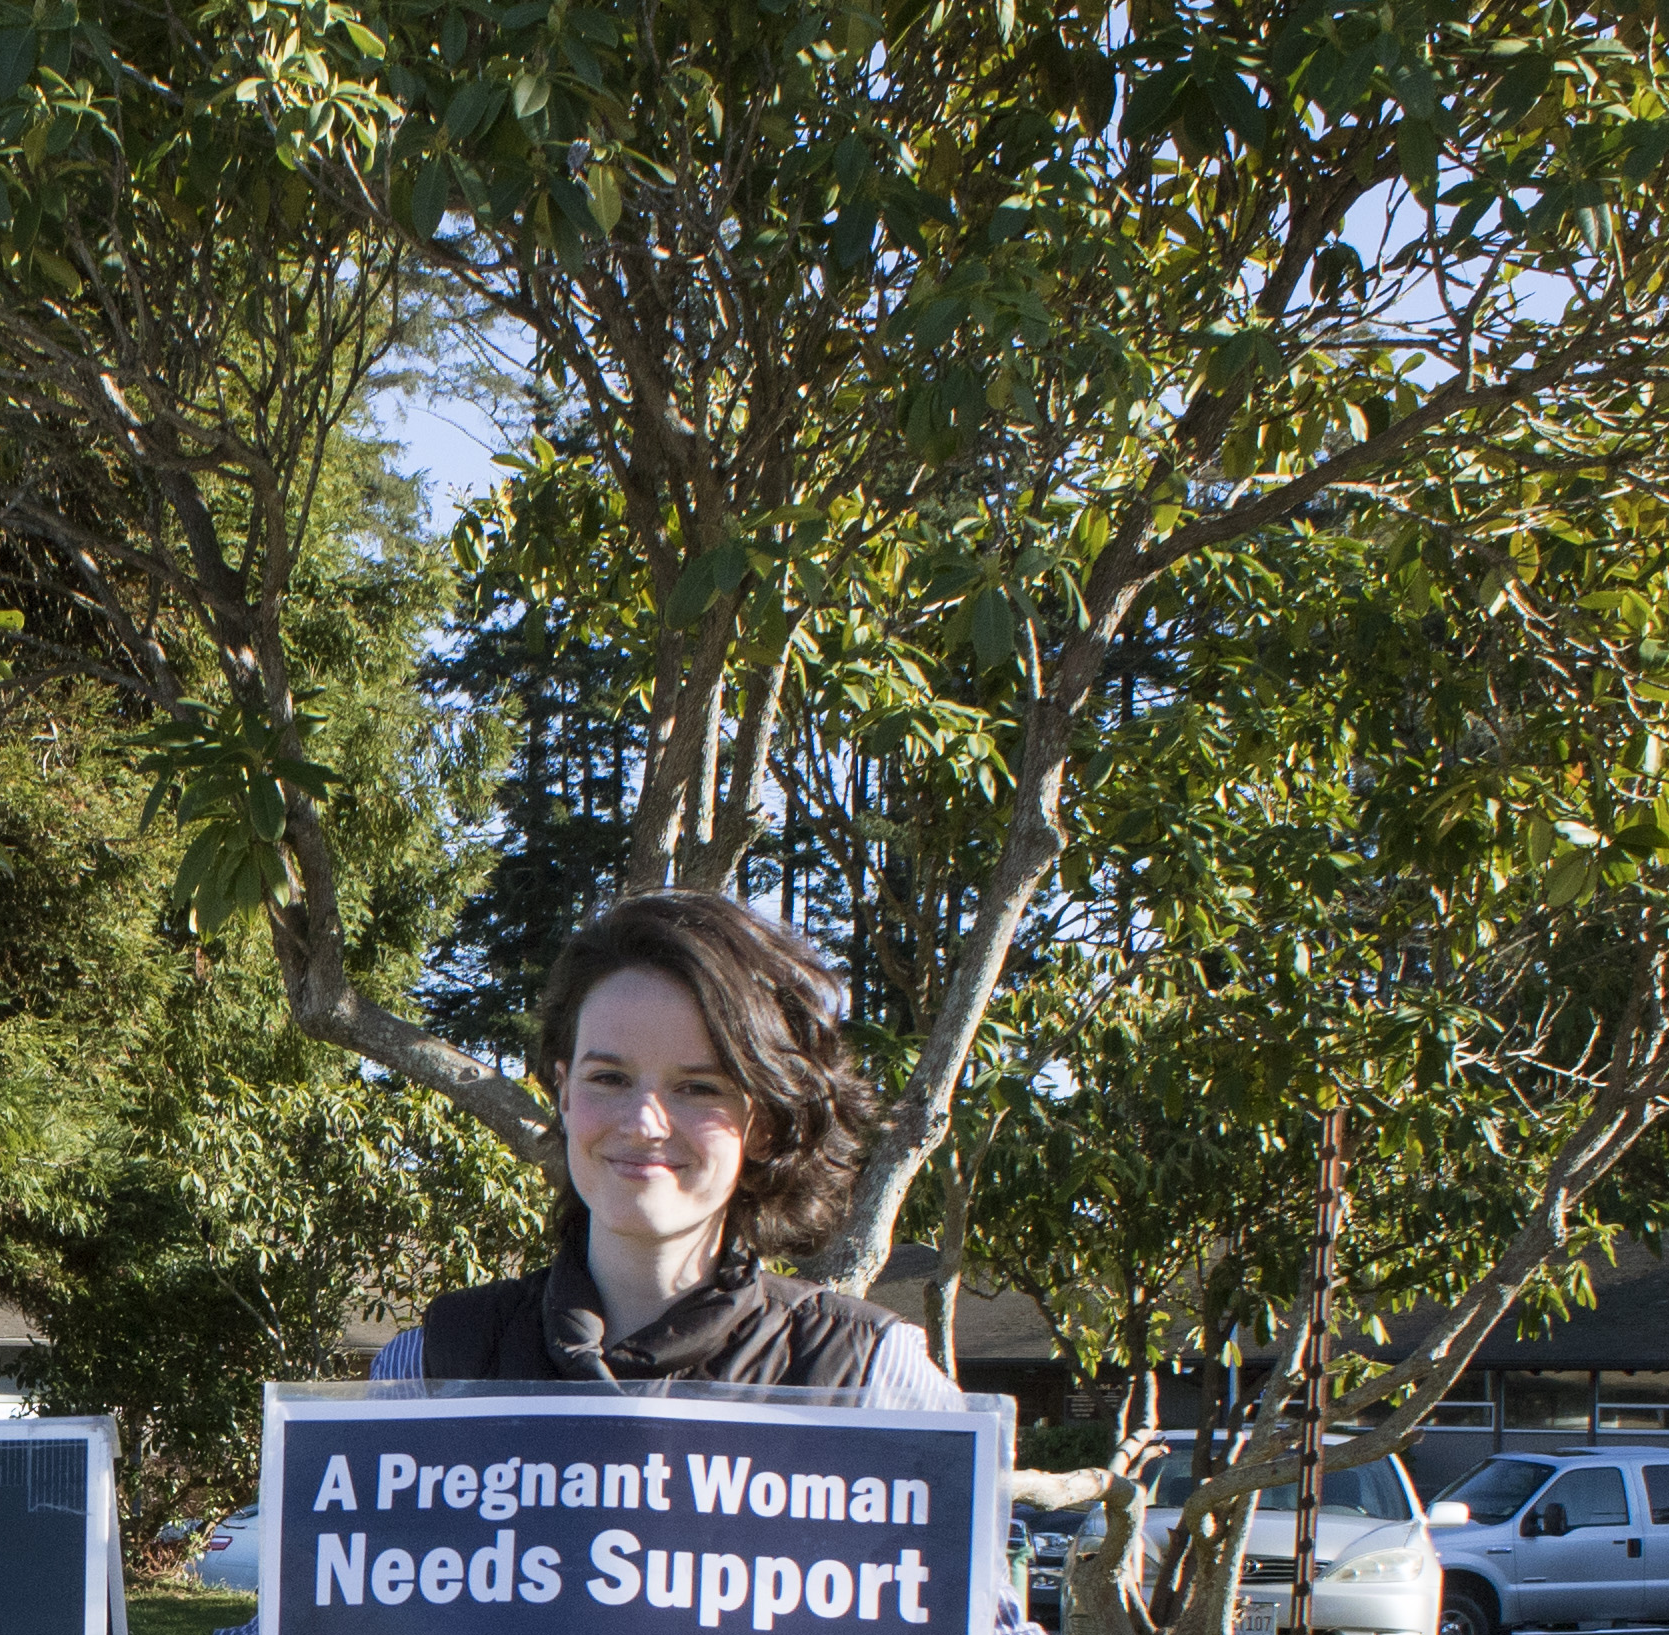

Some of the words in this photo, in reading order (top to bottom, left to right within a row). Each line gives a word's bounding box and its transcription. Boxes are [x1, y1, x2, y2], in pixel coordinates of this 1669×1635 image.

[313, 1455, 358, 1512] A
[377, 1452, 671, 1519] Pregnant
[687, 1454, 930, 1525] Woman
[314, 1530, 562, 1607] Needs
[587, 1529, 929, 1631] Support
